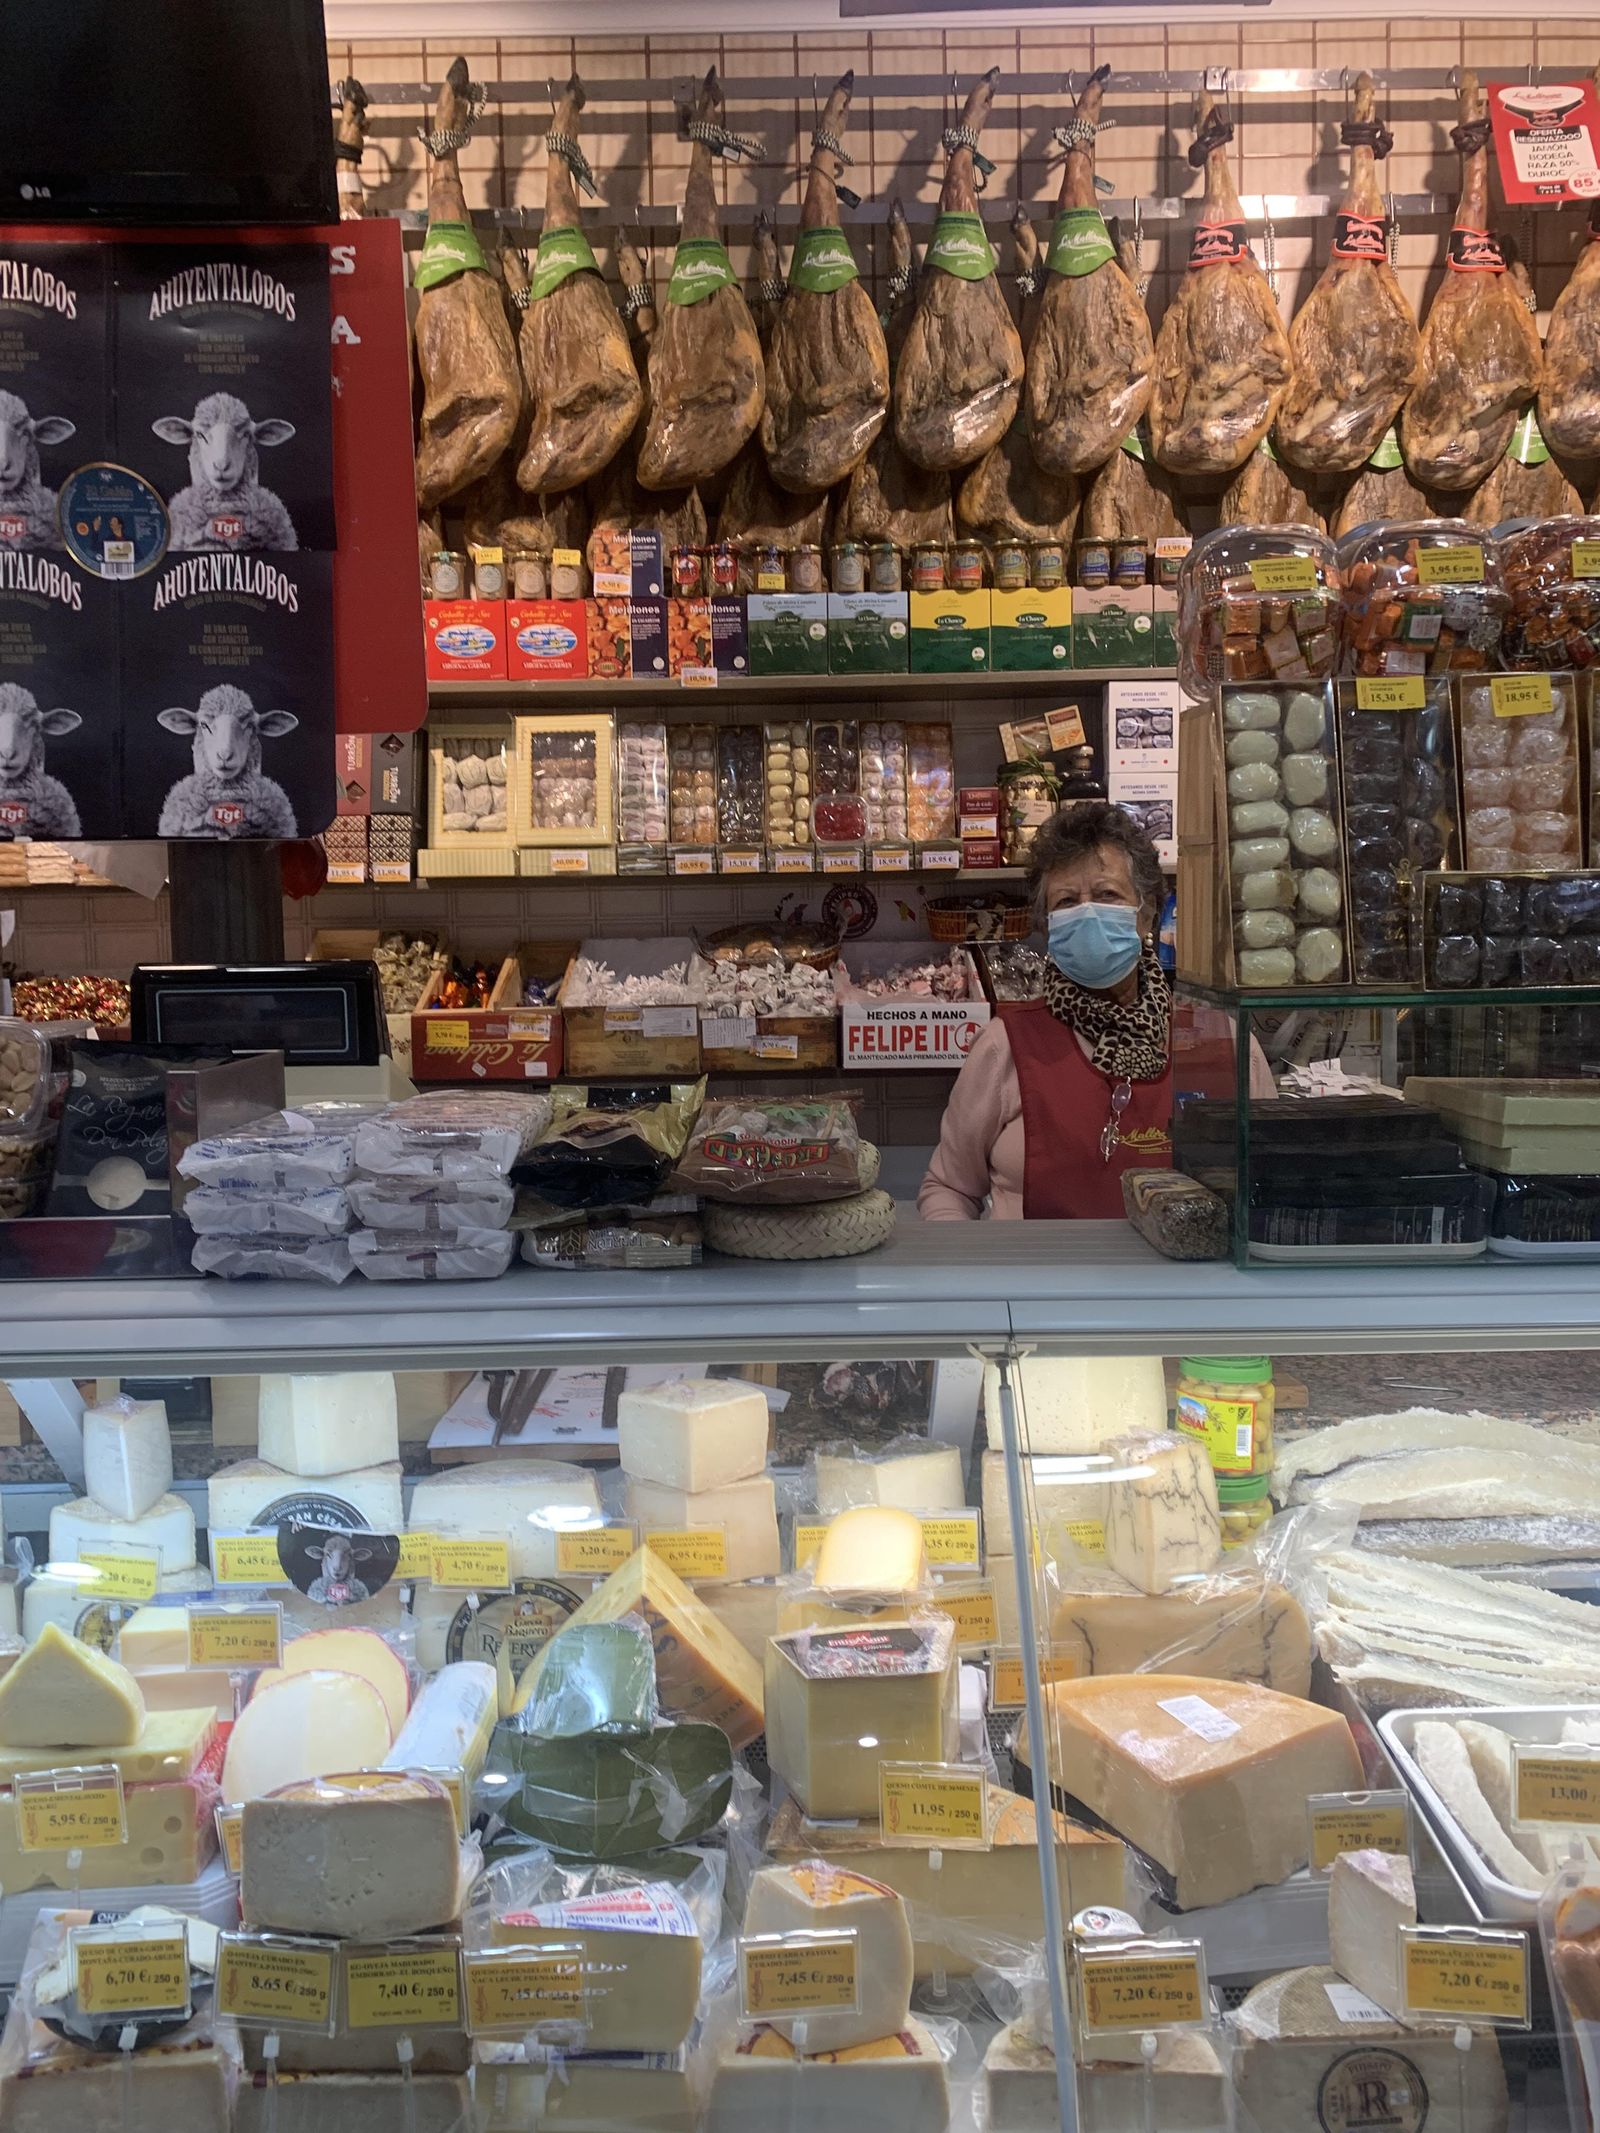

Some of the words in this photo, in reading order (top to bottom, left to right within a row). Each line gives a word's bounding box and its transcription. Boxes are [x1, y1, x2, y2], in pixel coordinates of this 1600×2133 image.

[1529, 128, 1563, 136] OFERTA
[1531, 143, 1568, 153] JAMÓN
[1529, 152, 1574, 161] BODEGA
[1528, 161, 1557, 169] RAZA
[1574, 178, 1593, 188] 85
[149, 262, 296, 322] AHUYENTALOBOS
[214, 520, 241, 539] Tgt
[612, 535, 657, 546] Mejillones
[1430, 566, 1450, 575] 3,95
[154, 553, 299, 613] AHUYENTALOBOS
[1265, 575, 1285, 584] 3,95
[608, 605, 660, 616] Mejillones
[689, 604, 741, 615] Mejillones
[1370, 693, 1396, 703] 15,30
[1399, 693, 1405, 702] €
[1506, 692, 1532, 703] 18,95
[1534, 692, 1539, 700] €
[214, 806, 241, 822] Tgt
[729, 859, 748, 867] 15,30
[879, 858, 898, 866] 18,95
[928, 855, 947, 864] 18,95
[331, 868, 351, 877] 11,95
[376, 868, 397, 877] 11,95
[867, 1011, 916, 1021] HECHOS
[920, 1010, 928, 1020] A
[931, 1010, 968, 1020] MANO
[848, 1025, 928, 1052] FELIPE
[517, 1042, 550, 1065] La
[900, 1053, 913, 1061] MÁS
[913, 1053, 946, 1061] PREMIADO
[580, 1546, 600, 1556] 3,20
[669, 1550, 691, 1560] 6,95
[237, 1557, 258, 1566] 6,45
[452, 1561, 472, 1571] 4,70
[969, 1616, 983, 1625] 250
[505, 1624, 548, 1636] Baquero
[215, 1636, 238, 1646] 7,20
[254, 1638, 268, 1646] 250
[1551, 1786, 1588, 1801] 13,00
[913, 1802, 945, 1817] 11,95
[954, 1809, 971, 1819] 250
[50, 1813, 76, 1827] 5,95
[93, 1816, 109, 1825] 250
[1337, 1834, 1361, 1847] 7,70
[1085, 1966, 1113, 1976] QUESO
[1114, 1965, 1149, 1974] CURADO
[105, 1970, 135, 1987] 6,70
[153, 1974, 171, 1984] 250
[777, 1970, 807, 1987] 7,45
[826, 1974, 844, 1984] 250
[1440, 1971, 1471, 1988] 7,20
[1491, 1980, 1510, 1991] 250
[299, 1986, 317, 1997] 250
[378, 1982, 408, 2000] 7,40
[427, 1986, 445, 1997] 250
[1113, 1985, 1144, 2002] 7,20
[1164, 1990, 1183, 2000] 250
